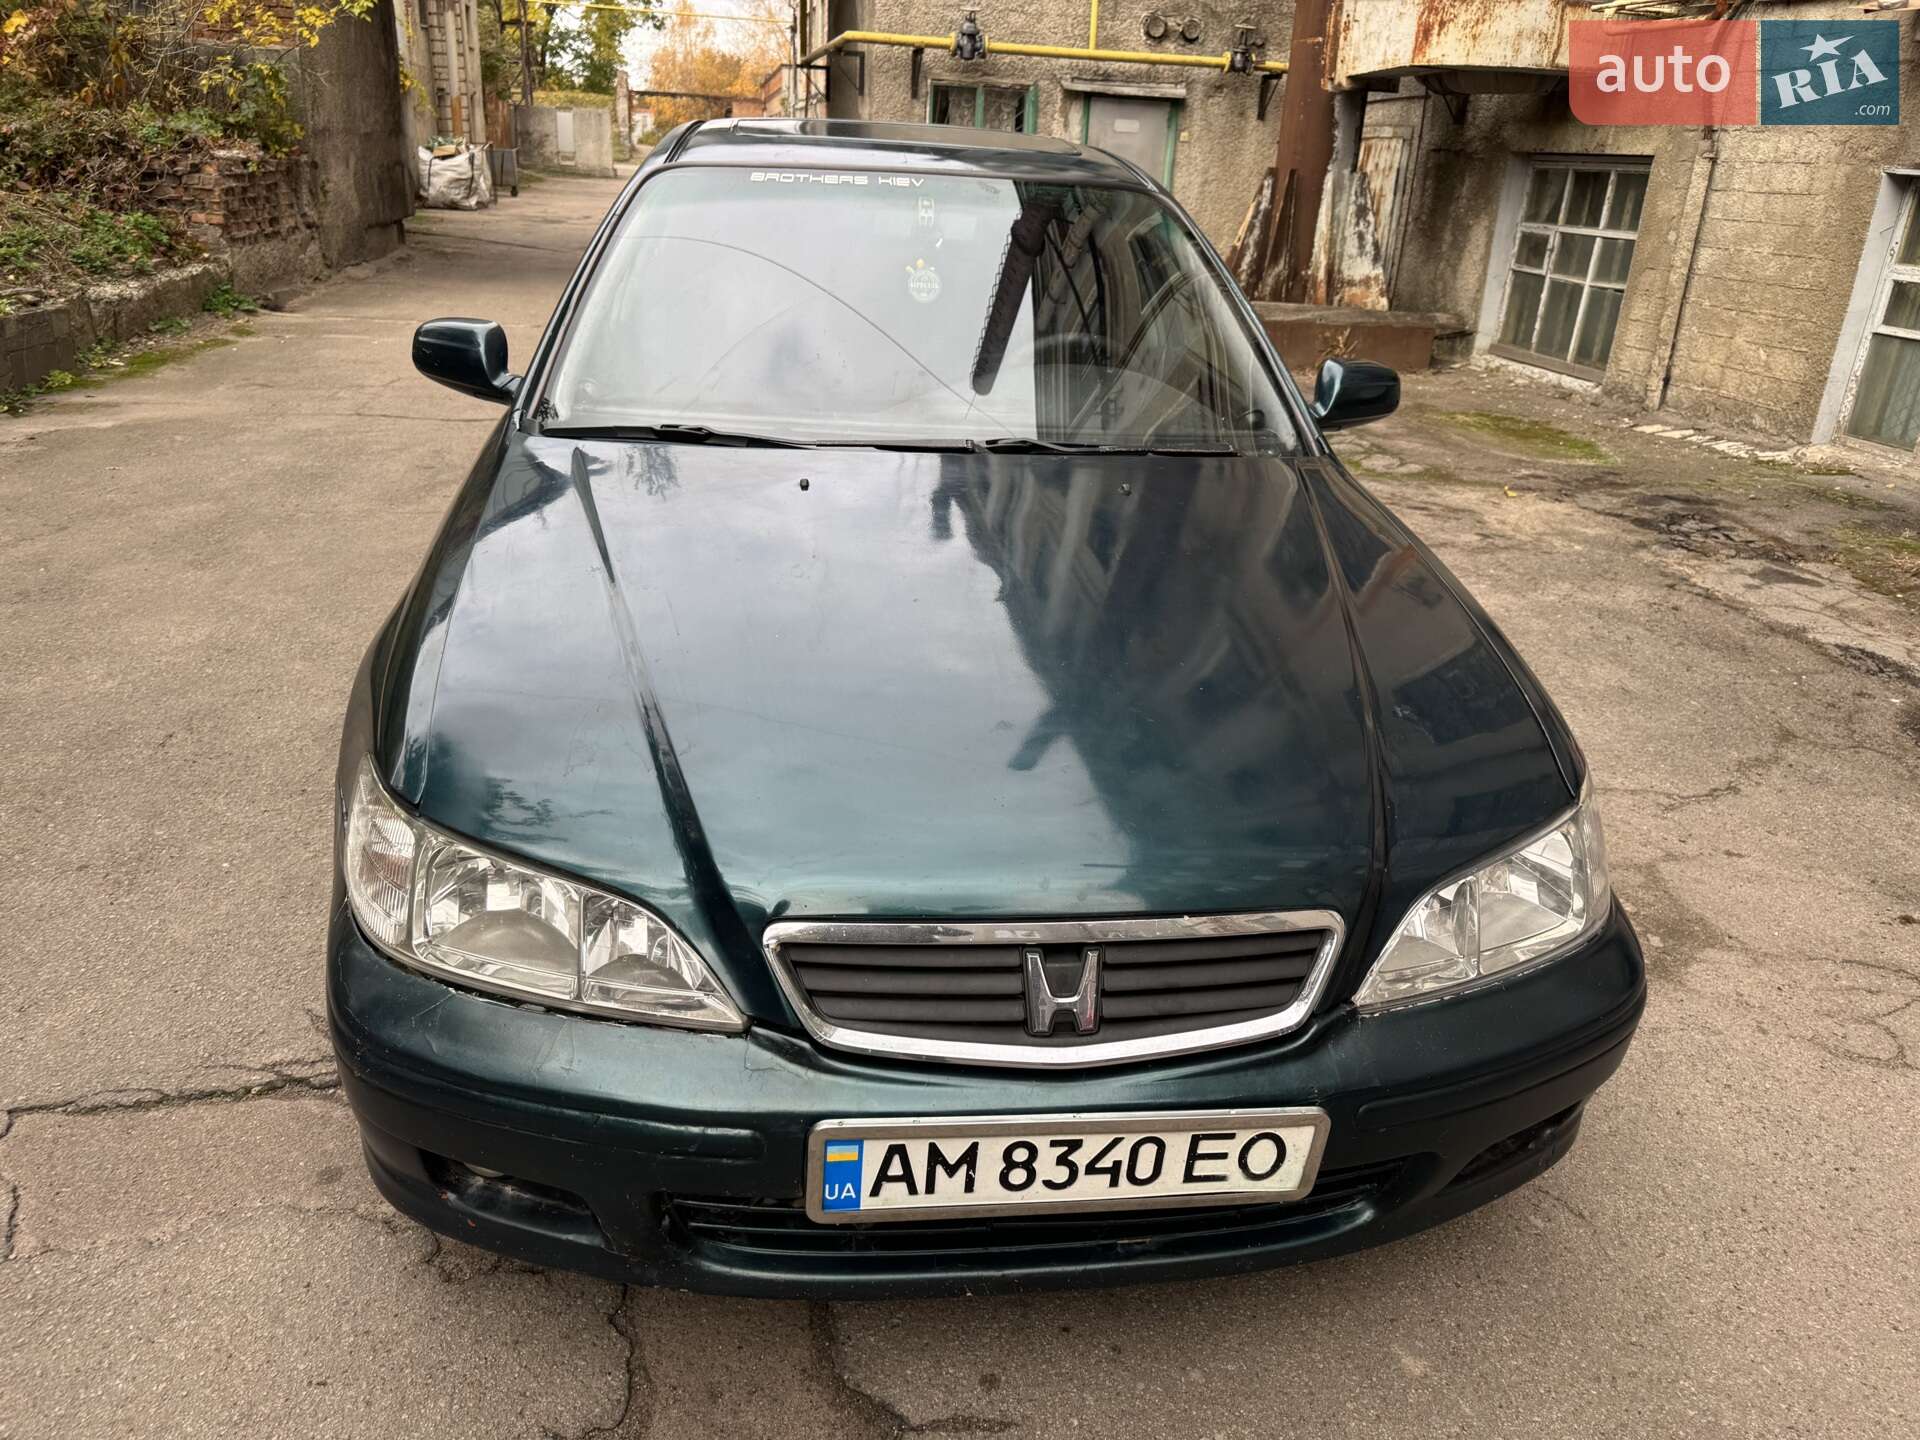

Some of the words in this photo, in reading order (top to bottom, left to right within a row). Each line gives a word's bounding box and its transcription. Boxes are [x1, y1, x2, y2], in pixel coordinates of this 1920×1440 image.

[750, 172, 868, 186] BROTHERS
[879, 176, 925, 188] KIEV
[869, 1142, 979, 1198] AM
[999, 1136, 1166, 1192] 8340
[1182, 1131, 1287, 1184] EO
[824, 1183, 856, 1200] UA
